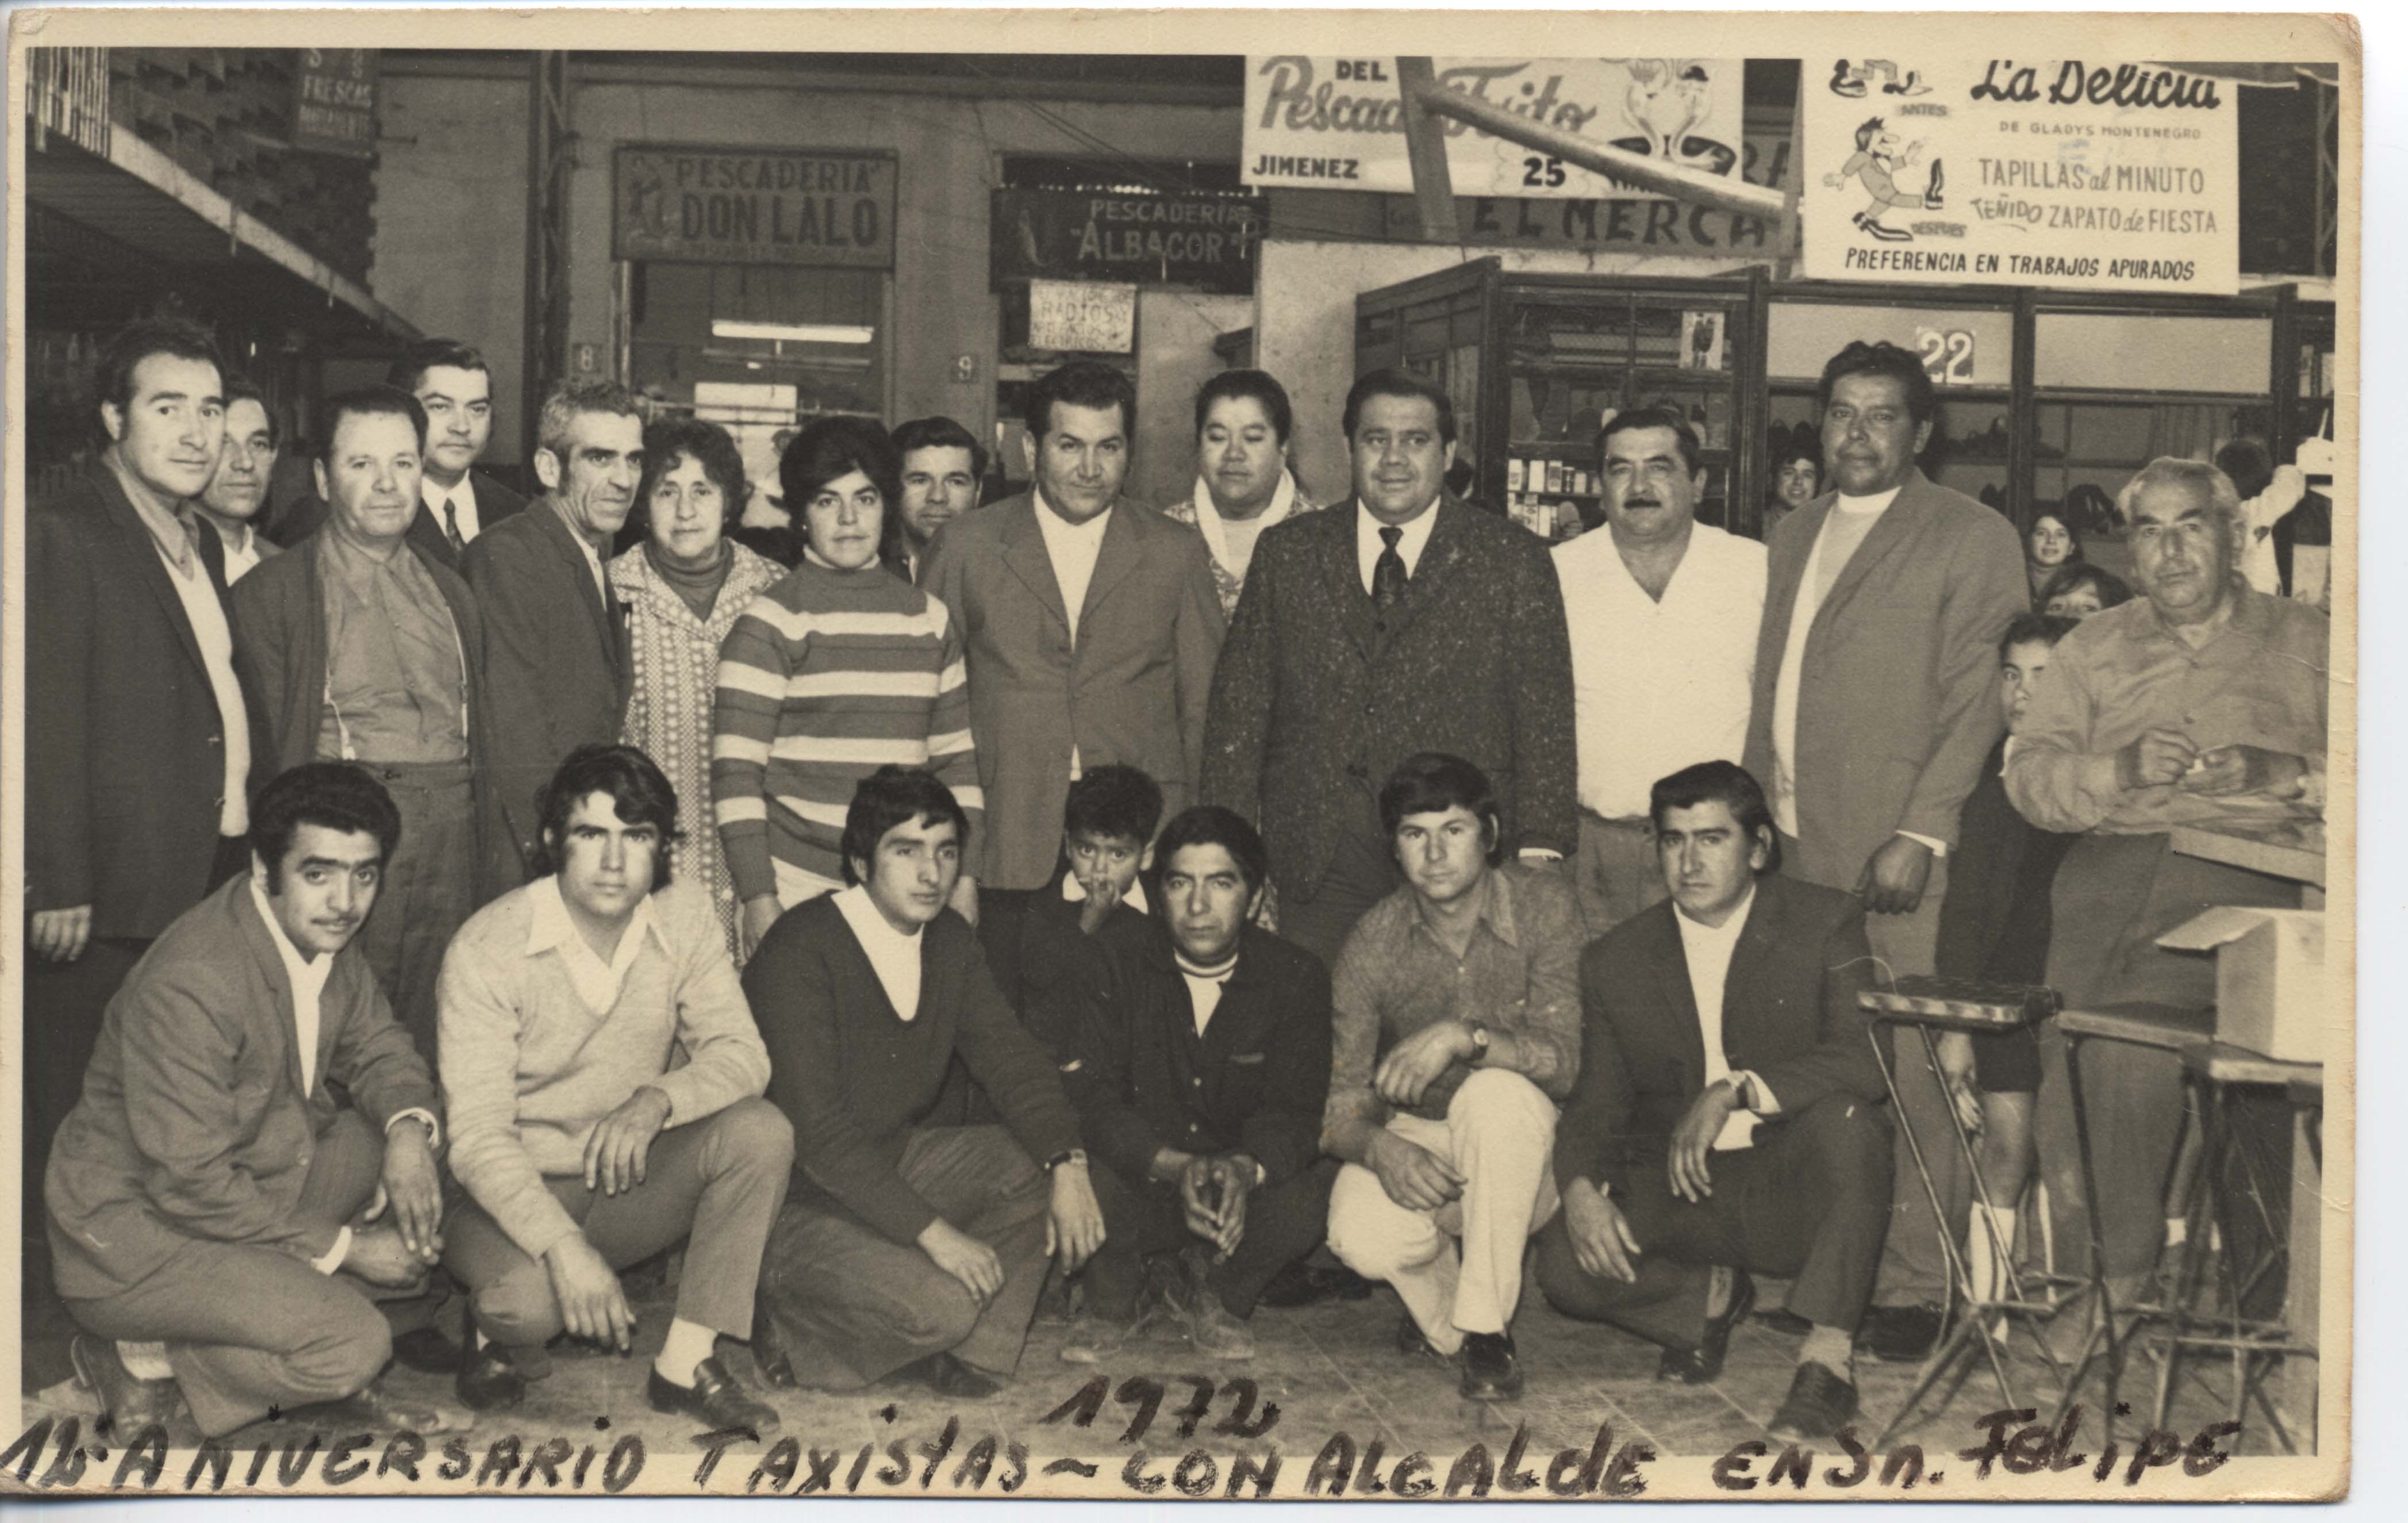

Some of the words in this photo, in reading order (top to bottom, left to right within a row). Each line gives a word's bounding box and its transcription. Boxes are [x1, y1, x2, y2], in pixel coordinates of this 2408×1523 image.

[1335, 60, 1388, 82] DEL
[1970, 60, 2040, 101] La
[2049, 60, 2221, 109] Delicia
[1901, 105, 1948, 116] ANTES
[1999, 121, 2019, 133] DE
[2030, 122, 2095, 136] GLADYS
[2101, 125, 2202, 140] MONTENEGRO
[1252, 155, 1359, 179] JIMENEZ
[1523, 156, 1566, 187] 25
[1979, 159, 2084, 190] TAPILLAS
[2090, 166, 2110, 192] al
[2117, 165, 2205, 194] MINUTO
[681, 193, 759, 243] DON
[771, 195, 878, 247] LALO
[1970, 193, 2042, 223] TEÑIDO
[2049, 205, 2122, 231] ZAPATO
[2123, 208, 2144, 232] de
[2148, 209, 2217, 233] FIESTA
[1845, 247, 1966, 272] PREFERENCIA
[1976, 254, 1999, 273] EN
[2010, 255, 2099, 277] TRABAJOS
[2108, 259, 2195, 281] APURADOS
[580, 347, 593, 371] 8
[958, 356, 972, 379] 9
[1921, 331, 1973, 383] 22
[1038, 1375, 1280, 1443] 1972
